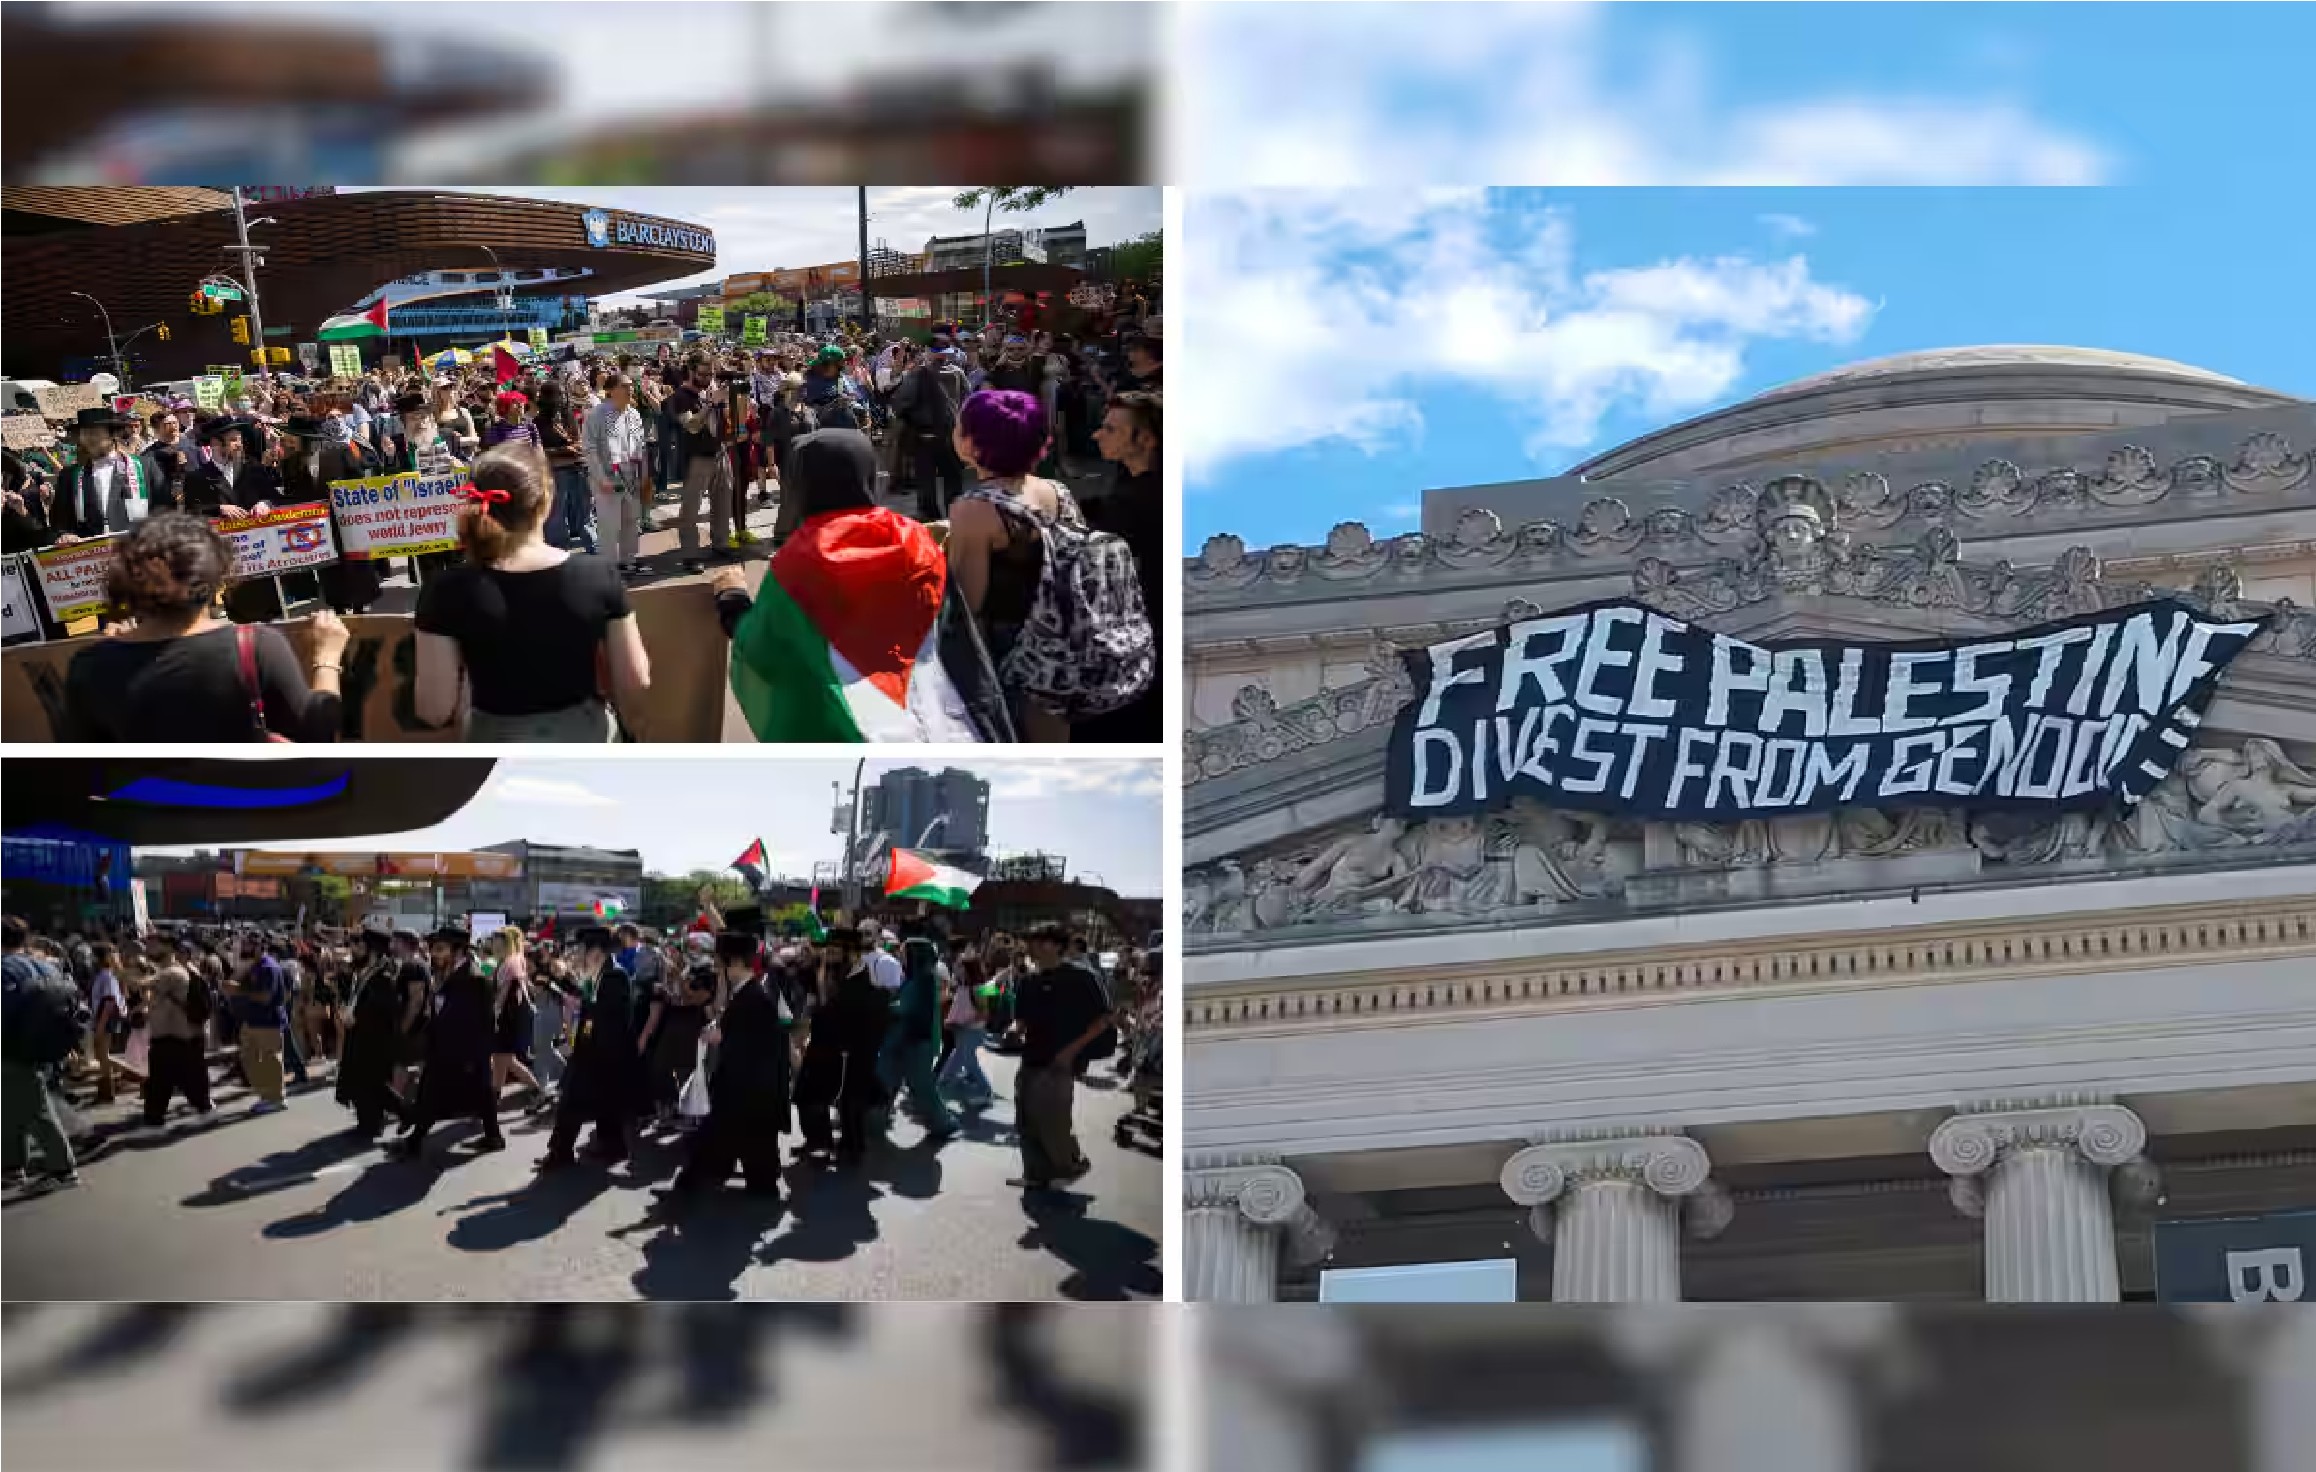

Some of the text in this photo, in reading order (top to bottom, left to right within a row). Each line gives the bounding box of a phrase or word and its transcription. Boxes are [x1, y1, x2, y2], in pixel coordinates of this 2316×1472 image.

[616, 219, 688, 248] BARCLAYS
[338, 511, 372, 526] does
[374, 506, 401, 523] not
[368, 519, 447, 540] world Jewry
[1418, 606, 1688, 727] FREE
[1410, 703, 1669, 807] DIVEST
[1664, 725, 1871, 809] FROM
